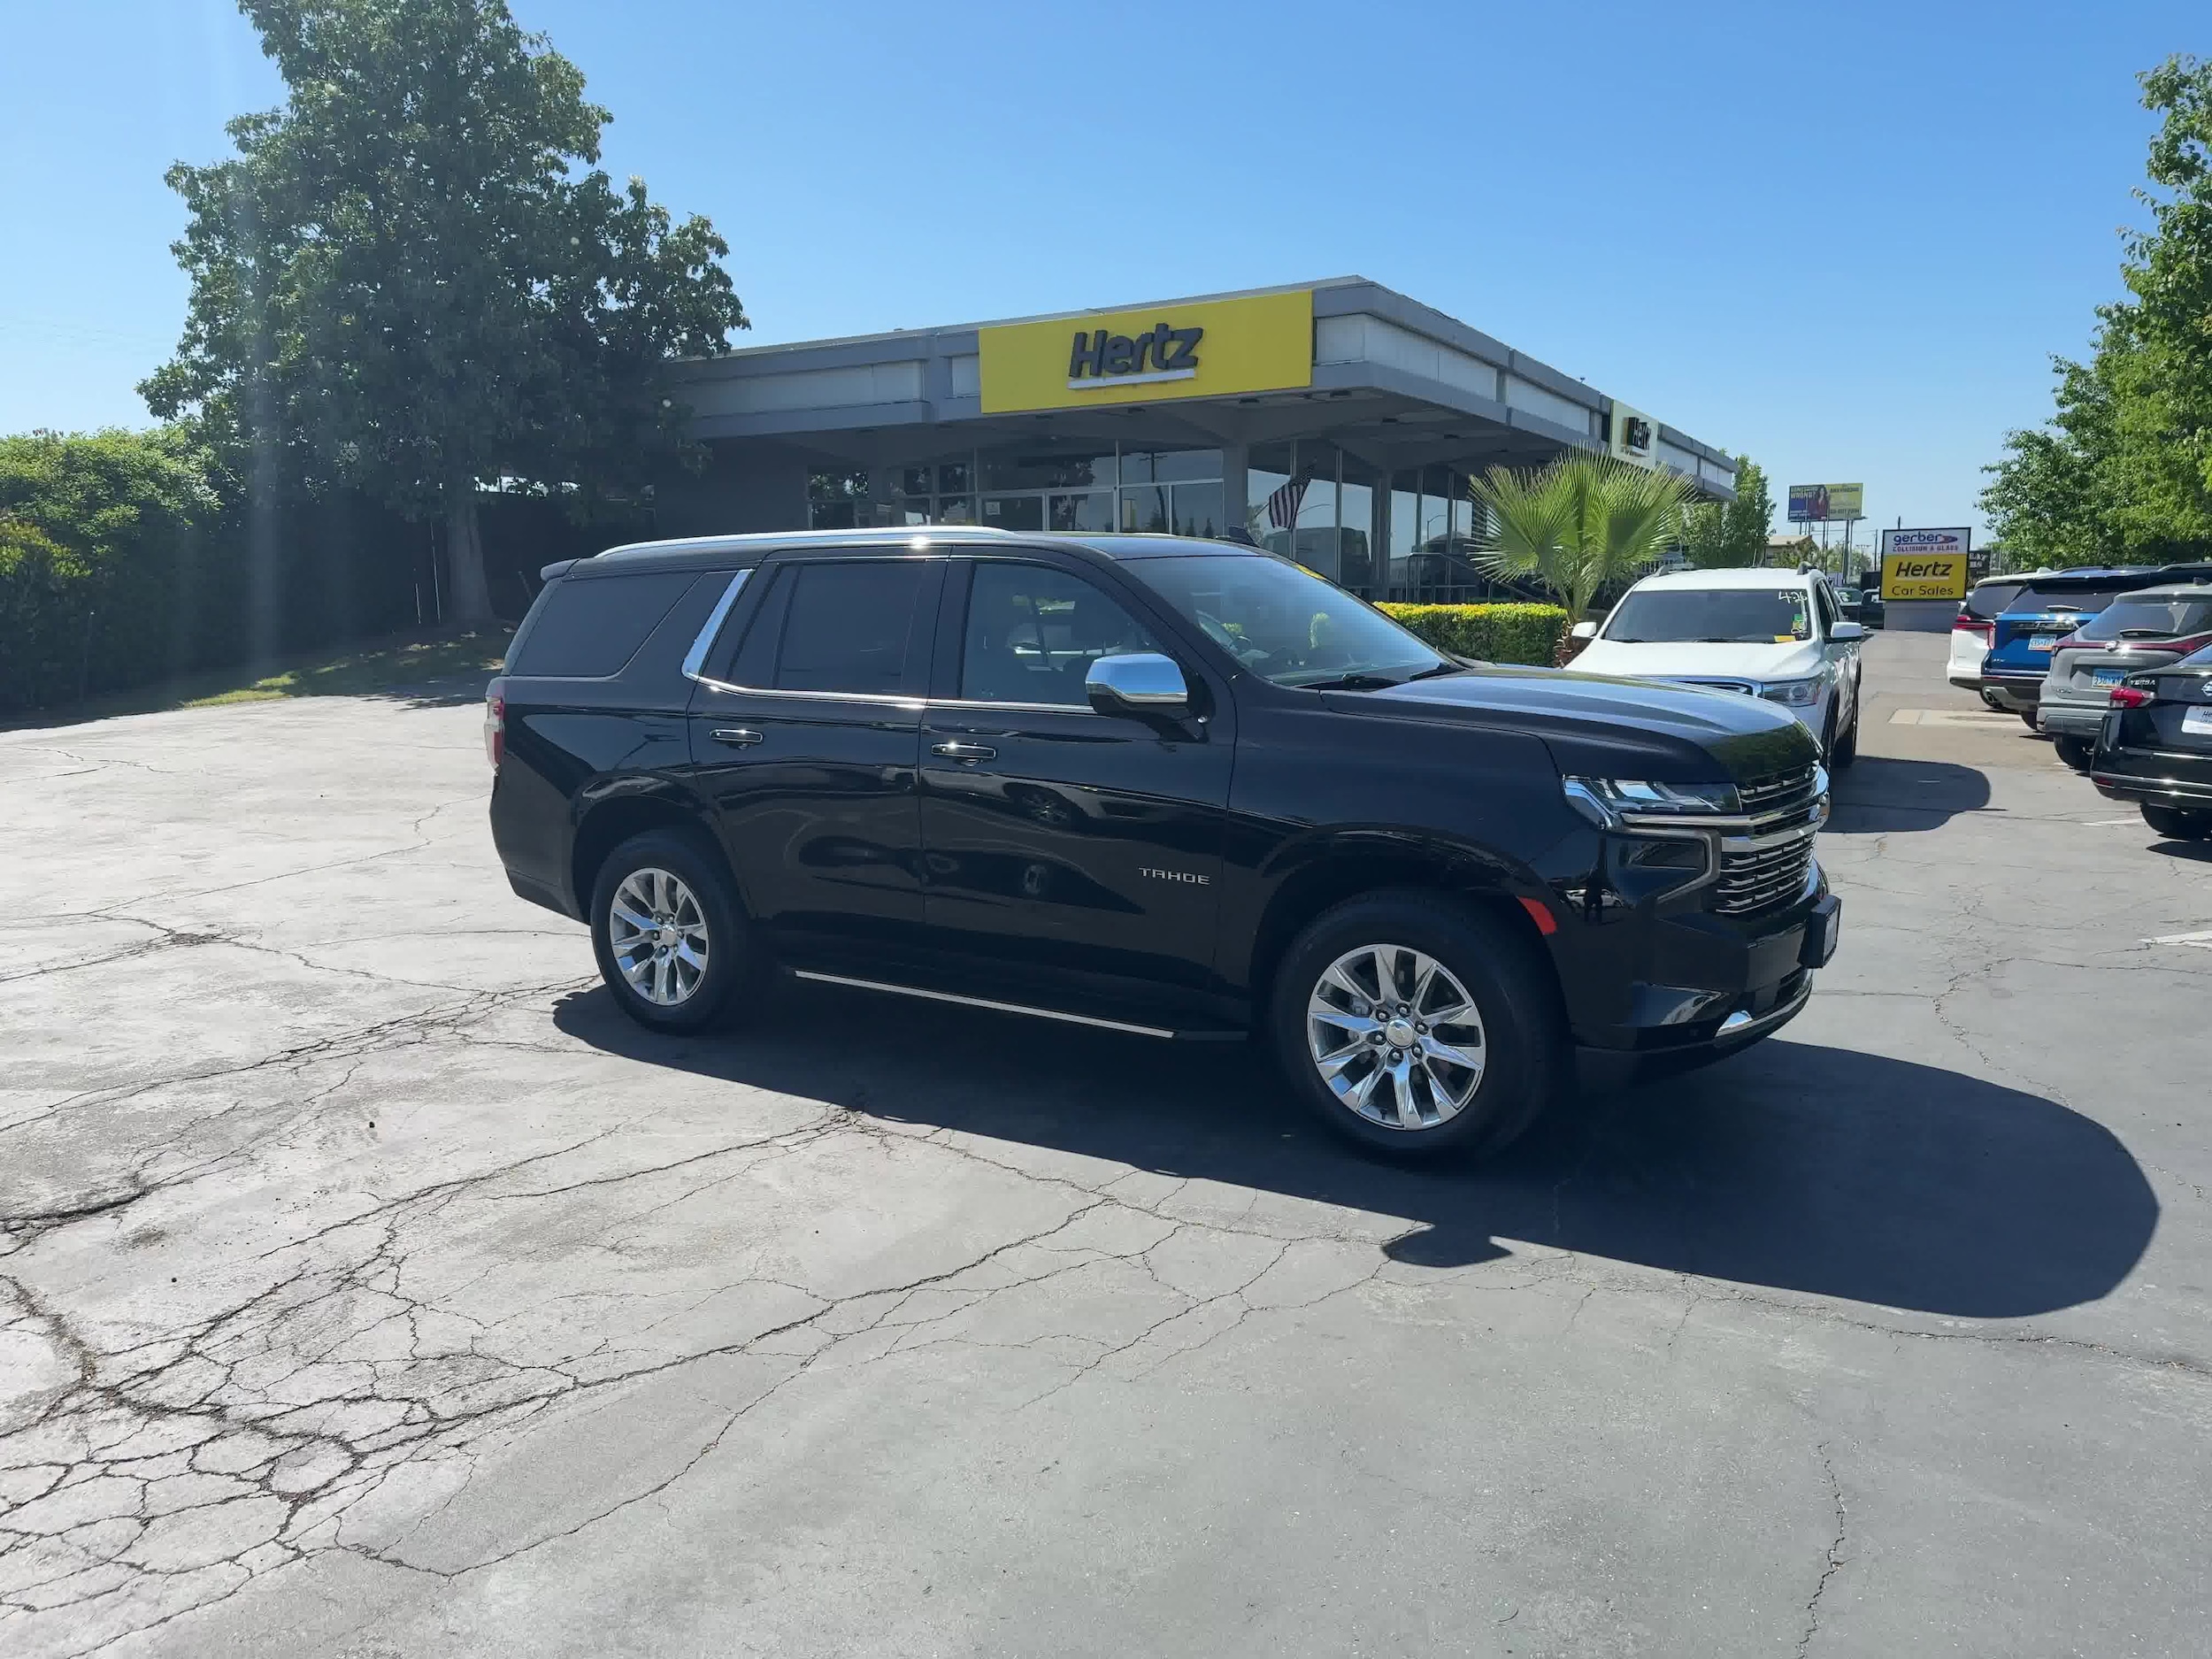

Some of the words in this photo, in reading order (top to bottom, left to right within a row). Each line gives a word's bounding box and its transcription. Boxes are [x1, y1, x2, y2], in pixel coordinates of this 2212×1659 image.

[1068, 323, 1203, 378] Hertz
[1893, 531, 1942, 545] gerber
[1895, 562, 1954, 577] Hertz
[1892, 586, 1914, 595] Car
[1919, 585, 1954, 595] Sales
[1138, 867, 1210, 885] TAHOE
